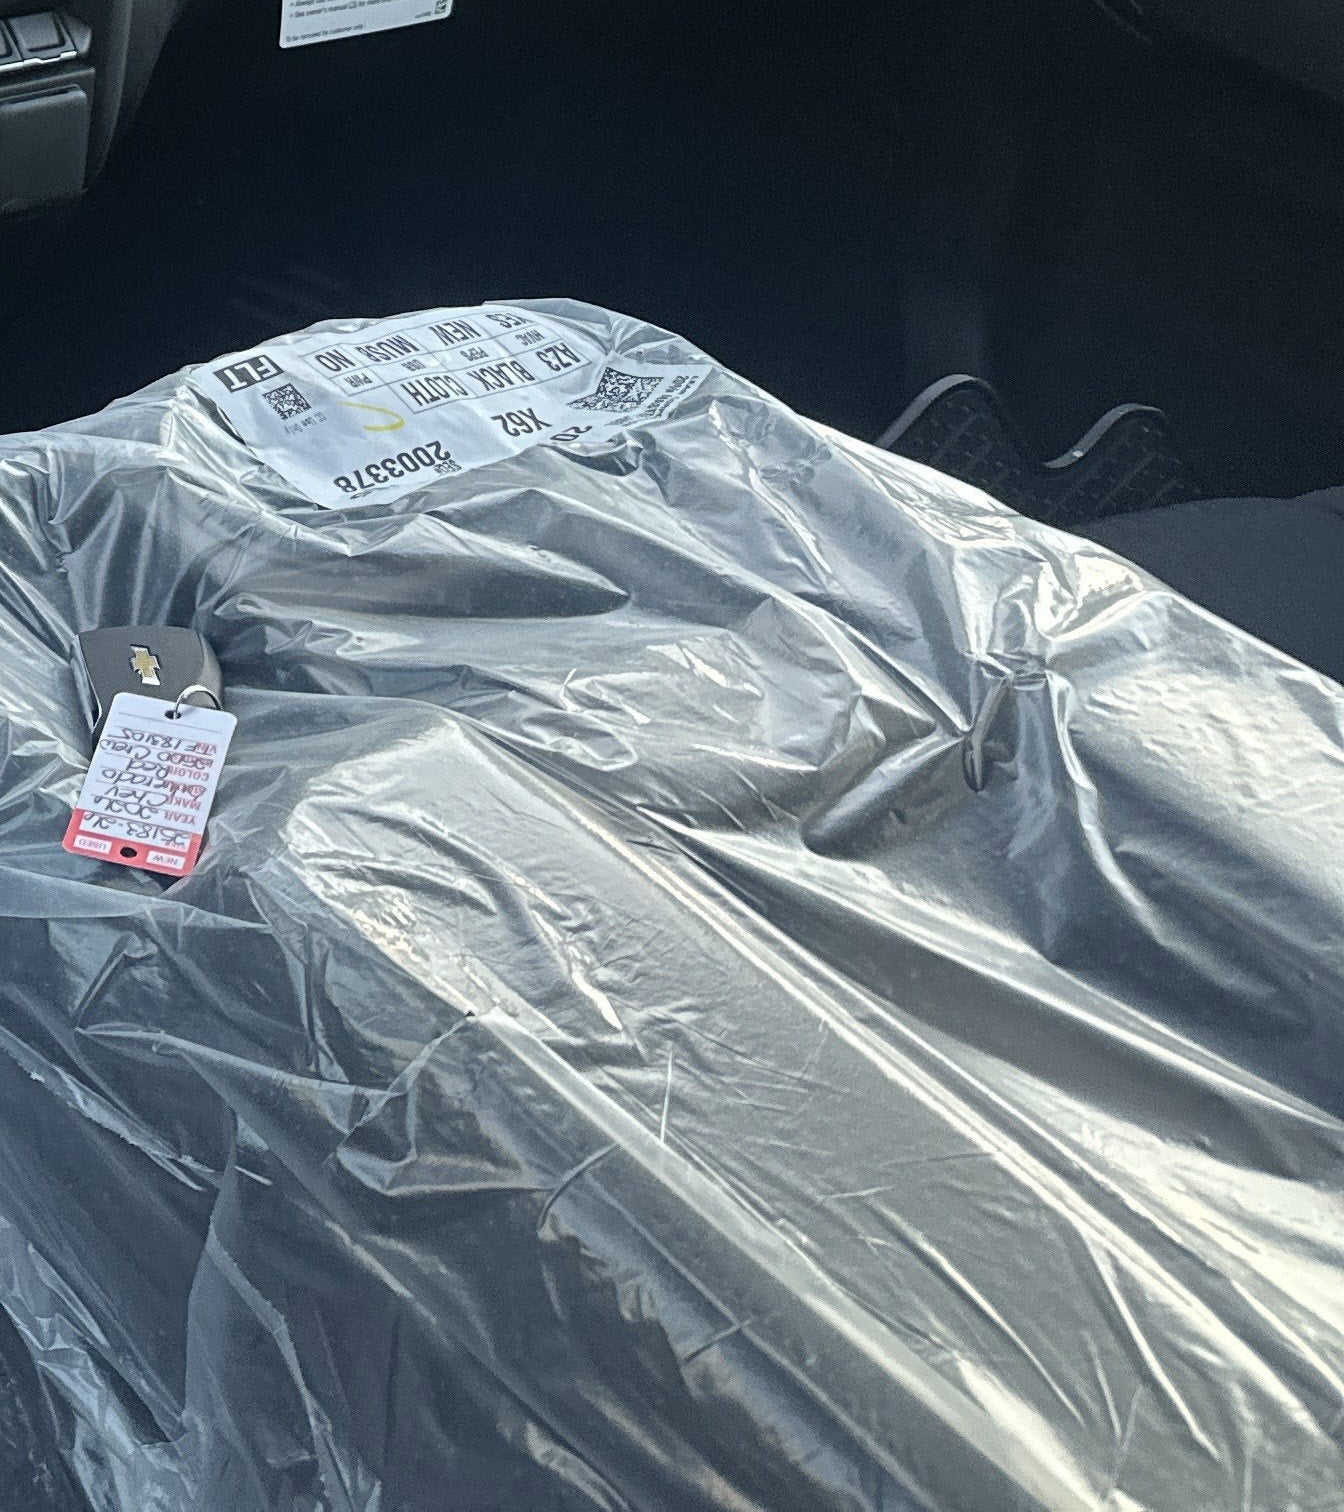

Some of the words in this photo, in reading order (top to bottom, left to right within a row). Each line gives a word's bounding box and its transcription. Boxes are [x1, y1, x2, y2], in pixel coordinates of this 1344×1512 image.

[485, 313, 529, 328] YES
[428, 319, 482, 346] NEW
[515, 329, 545, 346] HVAC
[315, 349, 356, 372] NO
[535, 342, 581, 372] AZ3
[223, 354, 274, 389] FLT
[344, 373, 373, 388] PWR
[466, 360, 535, 391] BLACK
[400, 375, 468, 407] CLOTH
[490, 408, 553, 437] X62
[333, 440, 451, 494] 2003378
[126, 758, 170, 779] Red
[167, 767, 210, 781] COLOR
[110, 785, 169, 806] Chev
[164, 810, 196, 825] YEAR
[78, 839, 107, 851] USED
[151, 854, 178, 866] NEW
